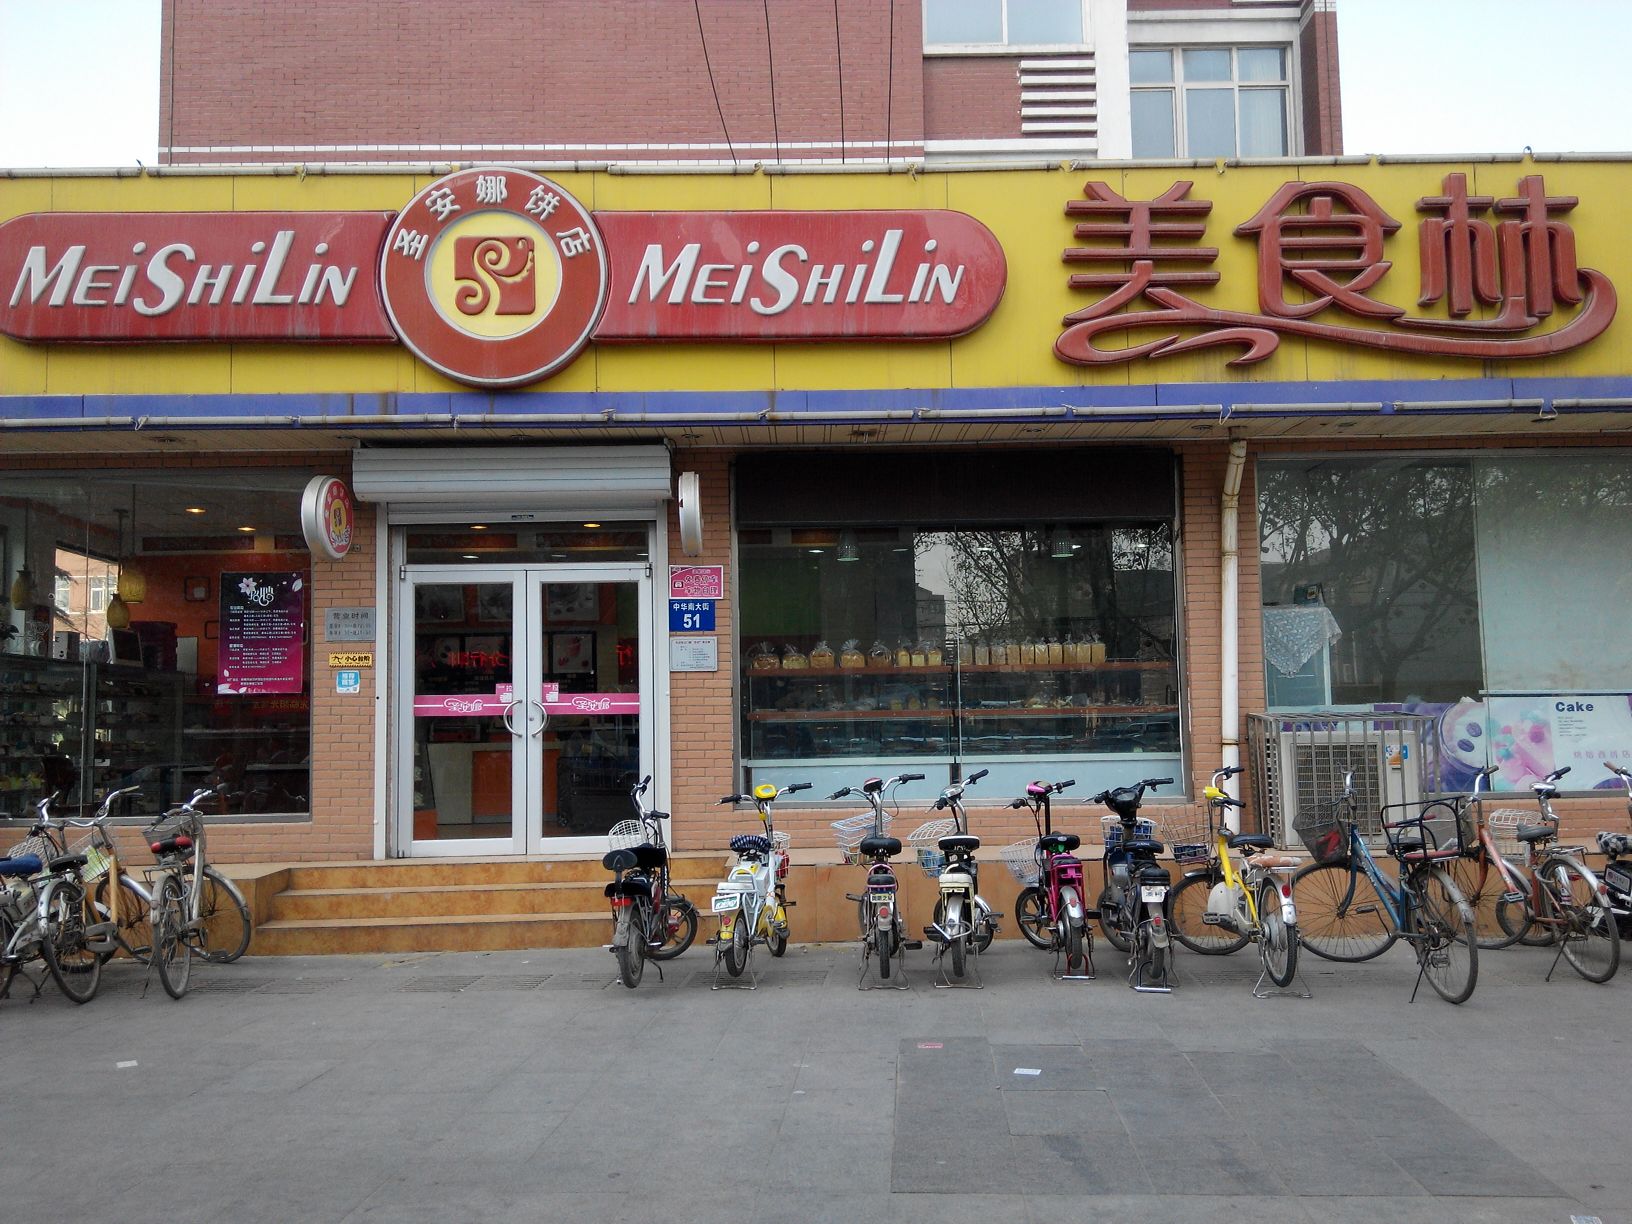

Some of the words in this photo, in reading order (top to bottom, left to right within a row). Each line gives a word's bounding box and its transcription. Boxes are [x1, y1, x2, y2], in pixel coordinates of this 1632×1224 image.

[393, 174, 591, 260] 圣安娜饼店
[672, 602, 710, 611] 中华南大街
[683, 613, 700, 629] 51
[1555, 701, 1594, 712] Cake
